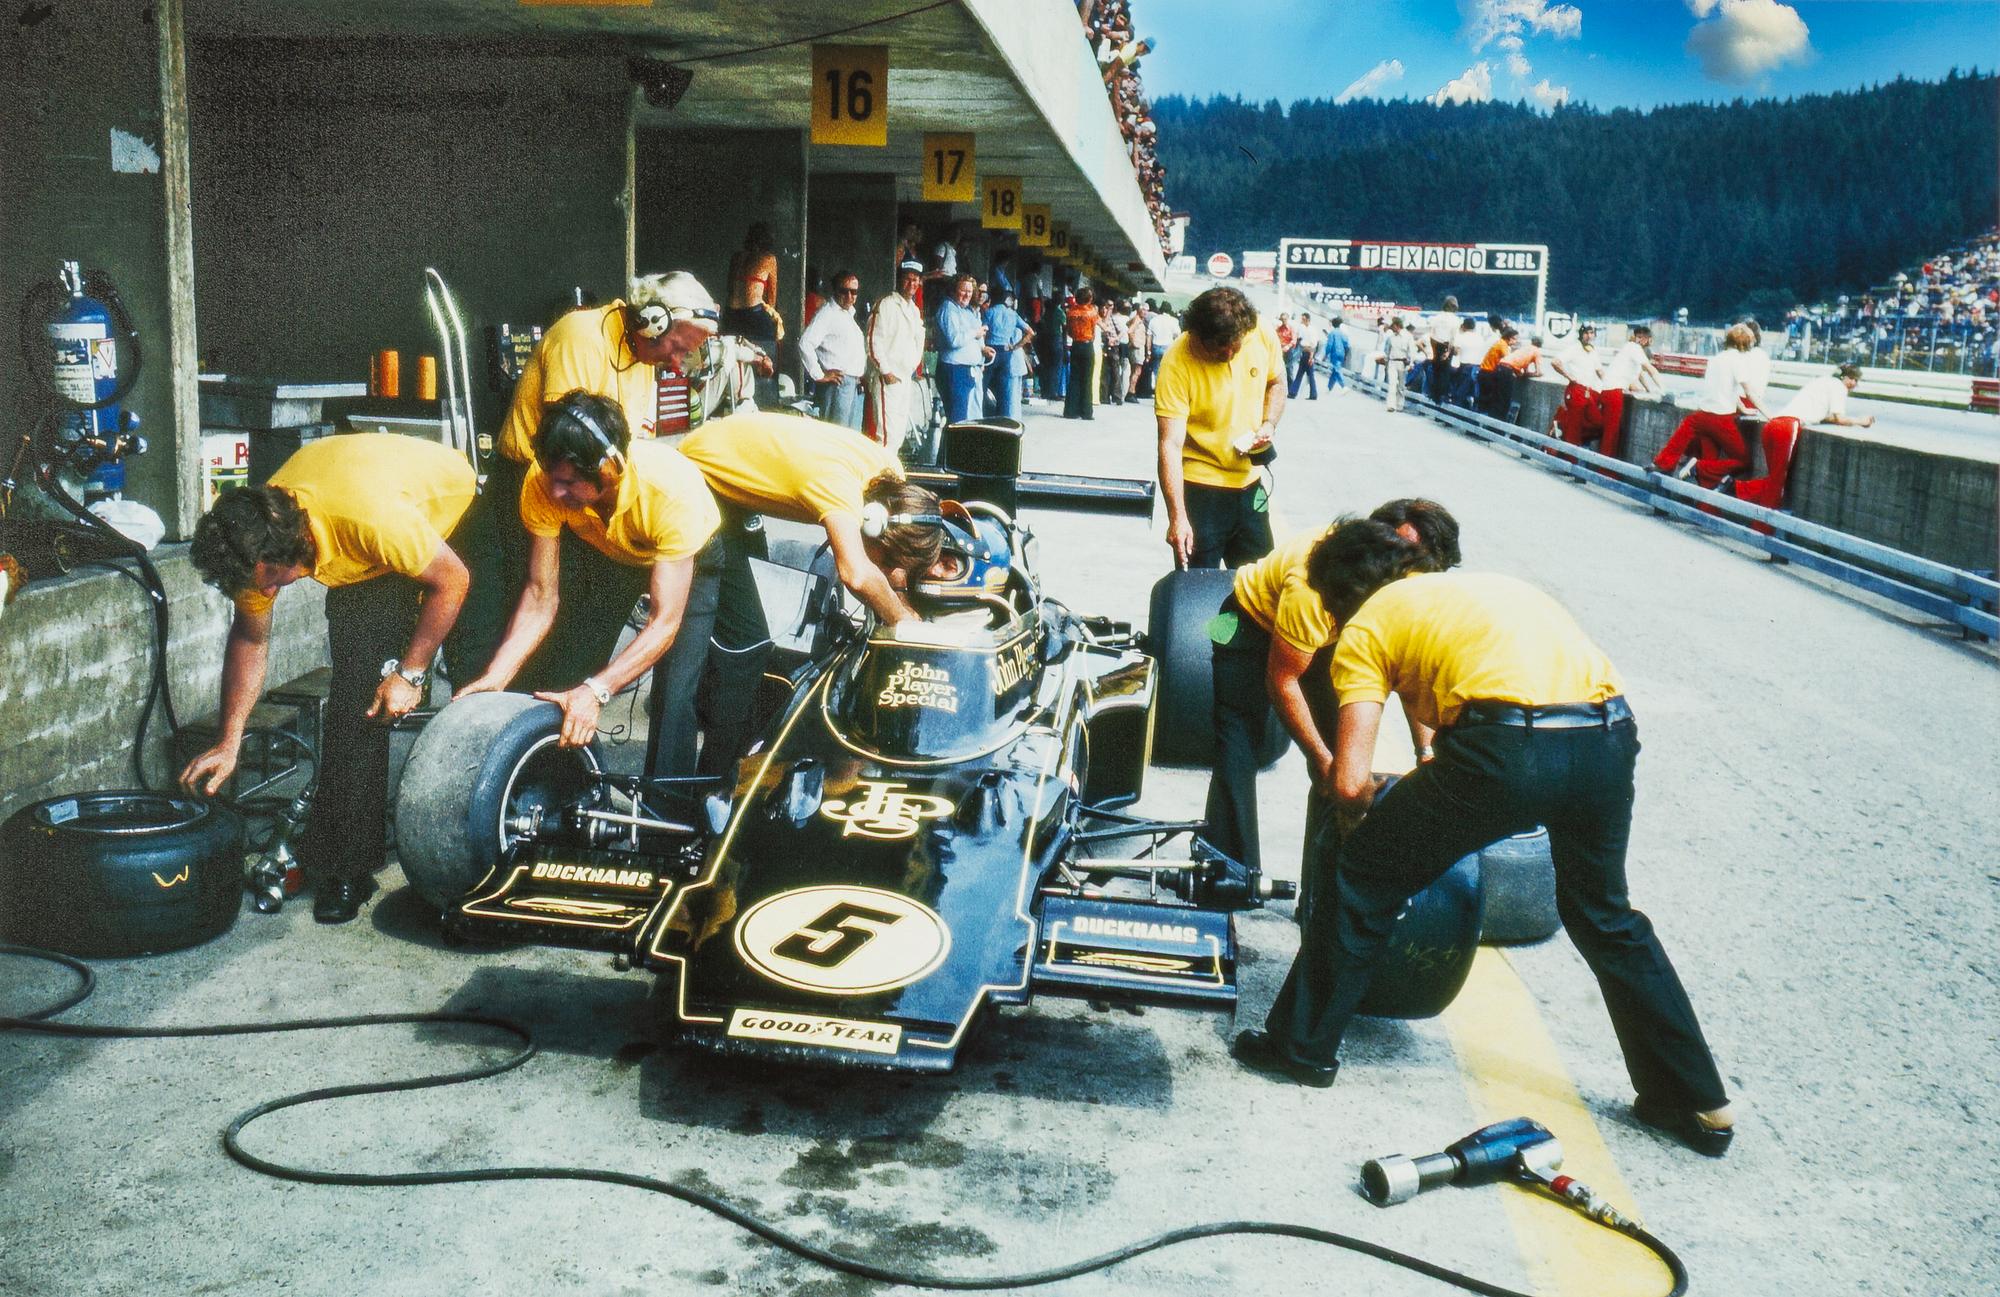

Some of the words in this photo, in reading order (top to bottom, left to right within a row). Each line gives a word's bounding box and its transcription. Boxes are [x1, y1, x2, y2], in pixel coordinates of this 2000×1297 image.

[826, 69, 873, 121] 16
[933, 150, 966, 185] 17
[990, 189, 1015, 217] 18
[1024, 214, 1045, 237] 19
[1291, 247, 1350, 264] START
[1364, 247, 1483, 269] TEXACO
[1495, 252, 1536, 269] ZIEL
[896, 661, 950, 681] John
[888, 674, 957, 696] Player
[878, 690, 958, 713] Special
[531, 862, 653, 888] DUCKHAMS
[770, 900, 908, 970] 5
[1073, 916, 1198, 944] DUCKHAMS
